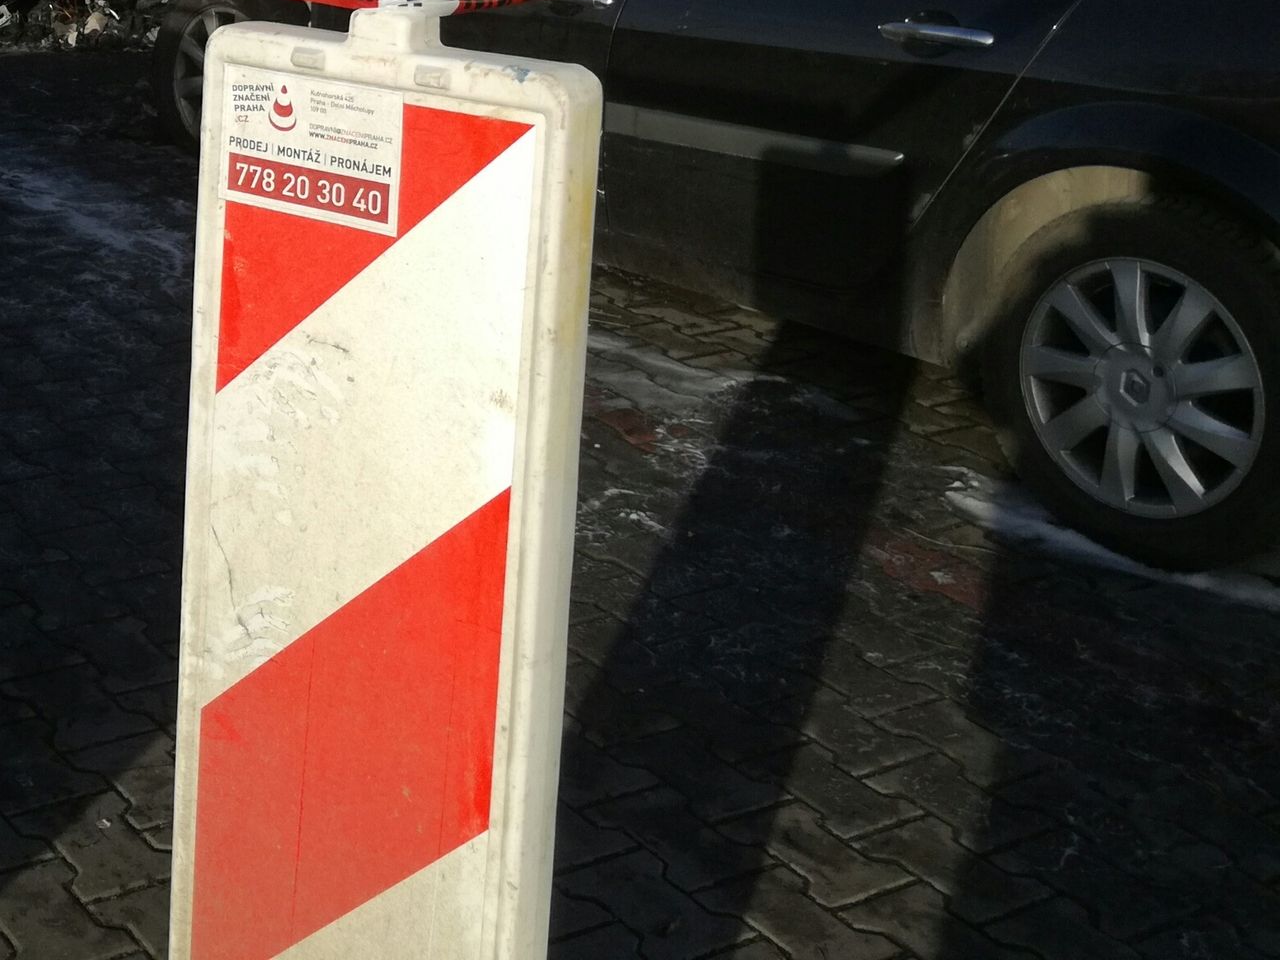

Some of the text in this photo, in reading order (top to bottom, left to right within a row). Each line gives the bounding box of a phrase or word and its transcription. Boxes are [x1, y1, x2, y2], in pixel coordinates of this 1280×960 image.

[232, 83, 274, 91] DOPRAVNÍ
[233, 93, 270, 101] ZNAČENÍ
[234, 104, 265, 112] PRAHA
[229, 136, 392, 178] PRODEJ MONTÁŽ PRONÁJEM
[236, 162, 382, 215] 778 20 30 40
